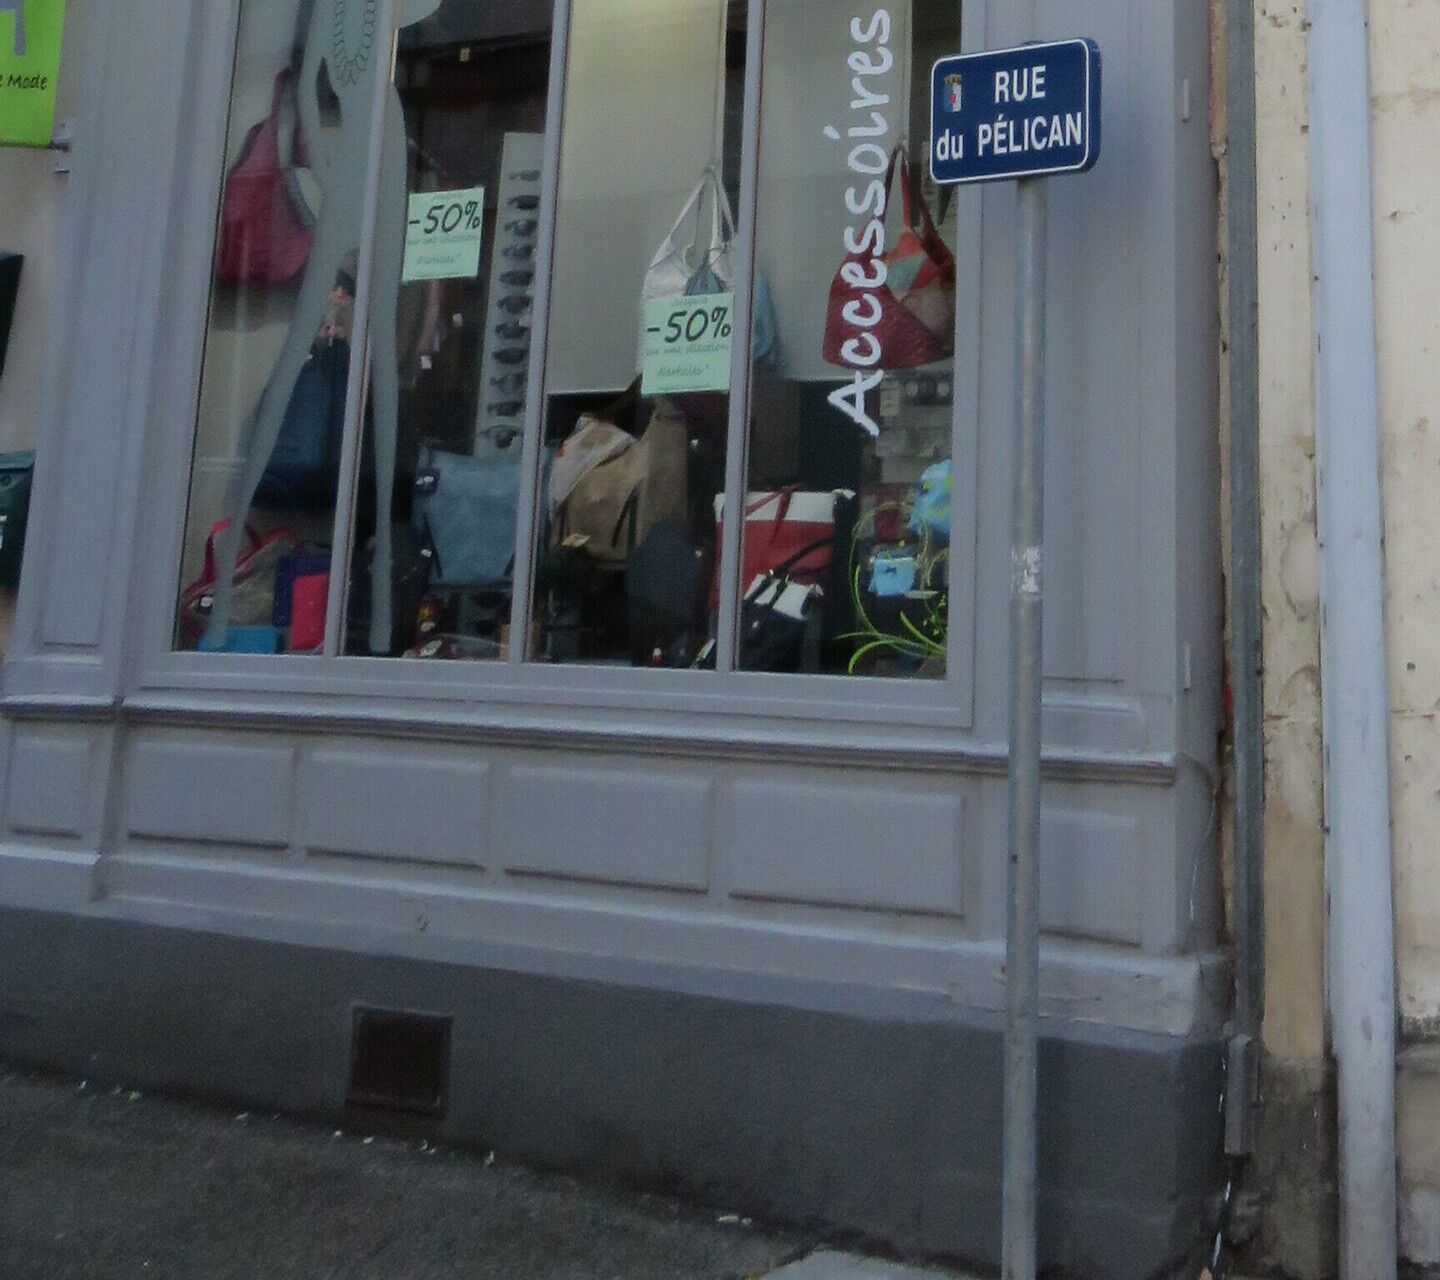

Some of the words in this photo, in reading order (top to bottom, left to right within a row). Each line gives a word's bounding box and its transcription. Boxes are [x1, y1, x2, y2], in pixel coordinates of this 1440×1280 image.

[7, 72, 48, 90] Mode
[995, 65, 1046, 103] RUE
[936, 129, 964, 161] du
[977, 112, 1082, 156] PÉLICAN
[408, 201, 480, 234] -50%
[823, 8, 893, 437] Accessoires
[646, 306, 732, 343] -50%
